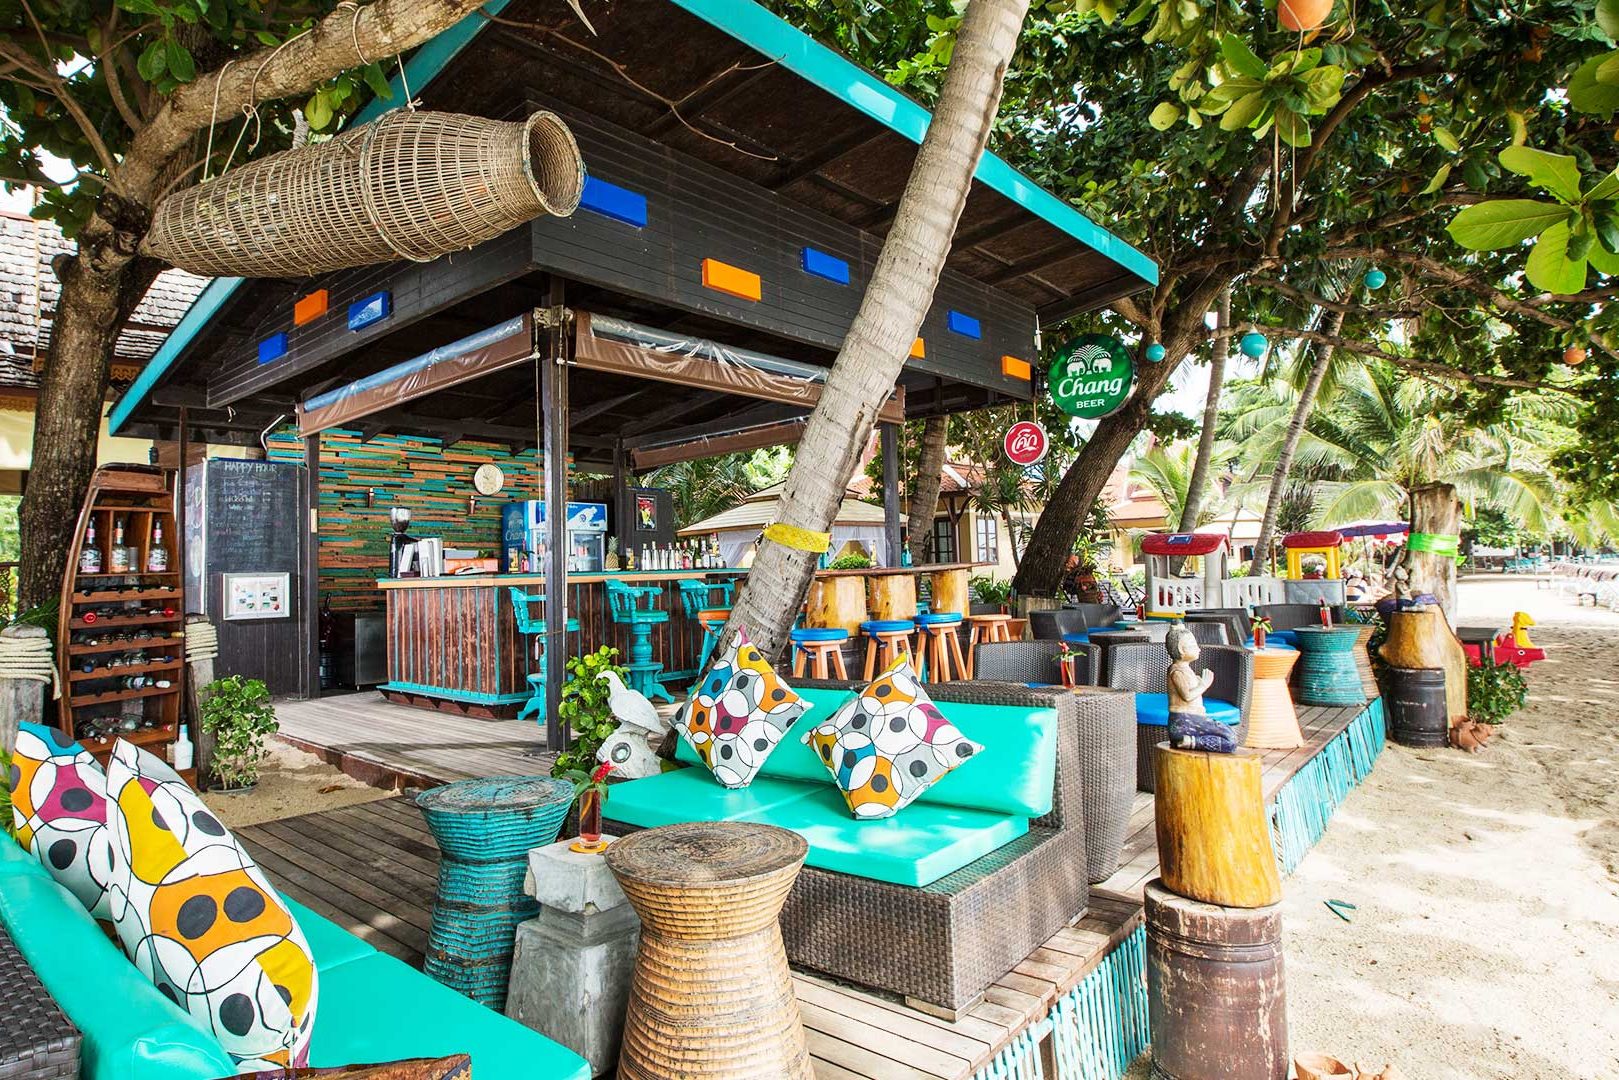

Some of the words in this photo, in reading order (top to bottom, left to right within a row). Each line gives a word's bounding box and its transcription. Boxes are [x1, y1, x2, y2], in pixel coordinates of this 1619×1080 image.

[1058, 377, 1123, 398] Chang
[1076, 398, 1105, 409] BEER
[224, 461, 253, 473] HAPPY
[255, 463, 278, 474] HOUR
